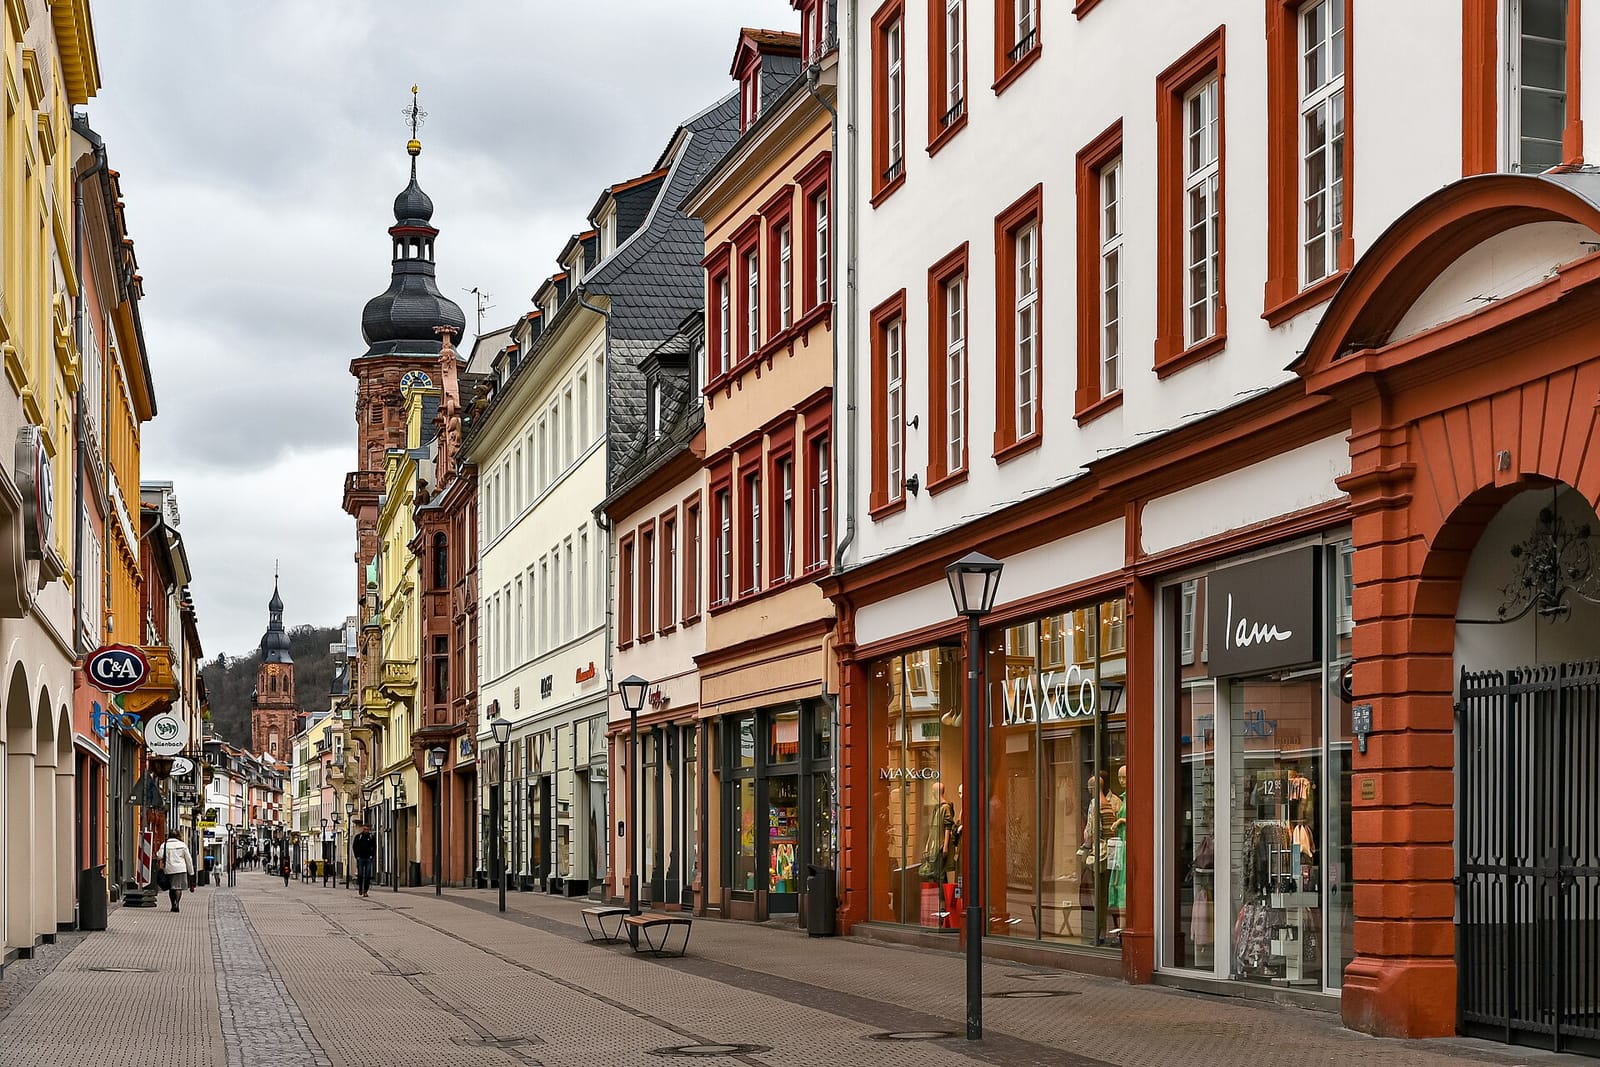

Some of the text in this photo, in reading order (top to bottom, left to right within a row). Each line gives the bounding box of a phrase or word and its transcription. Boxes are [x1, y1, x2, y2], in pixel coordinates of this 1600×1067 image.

[1226, 592, 1292, 651] I am
[97, 658, 138, 679] C&A
